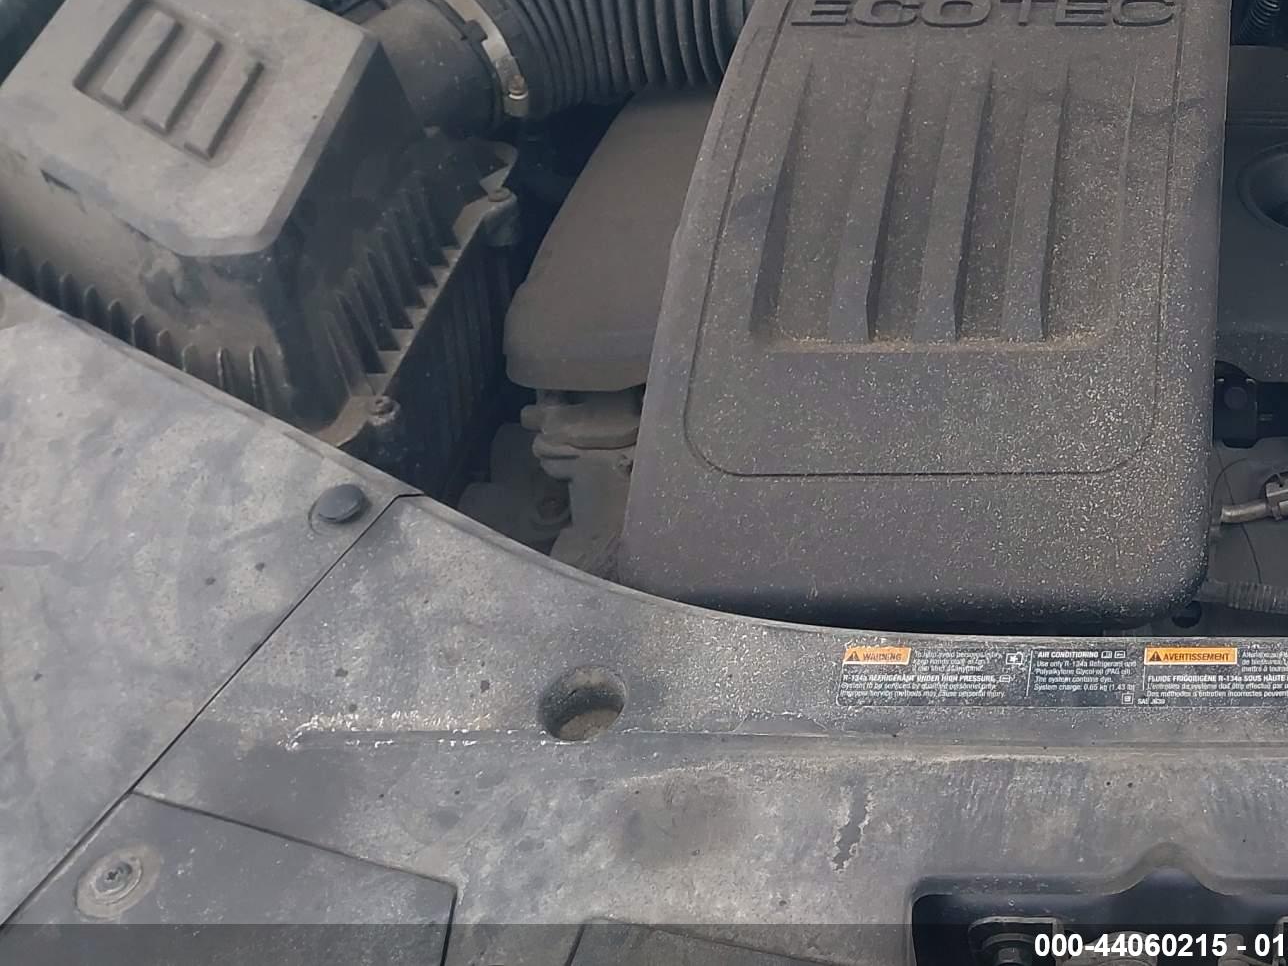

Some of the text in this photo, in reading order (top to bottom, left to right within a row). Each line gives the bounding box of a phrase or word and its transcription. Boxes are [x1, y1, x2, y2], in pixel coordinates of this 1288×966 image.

[862, 652, 902, 662] WARNING
[1037, 651, 1099, 659] AIR CONDITIONING
[1162, 653, 1230, 661] AVERTISSEMENT
